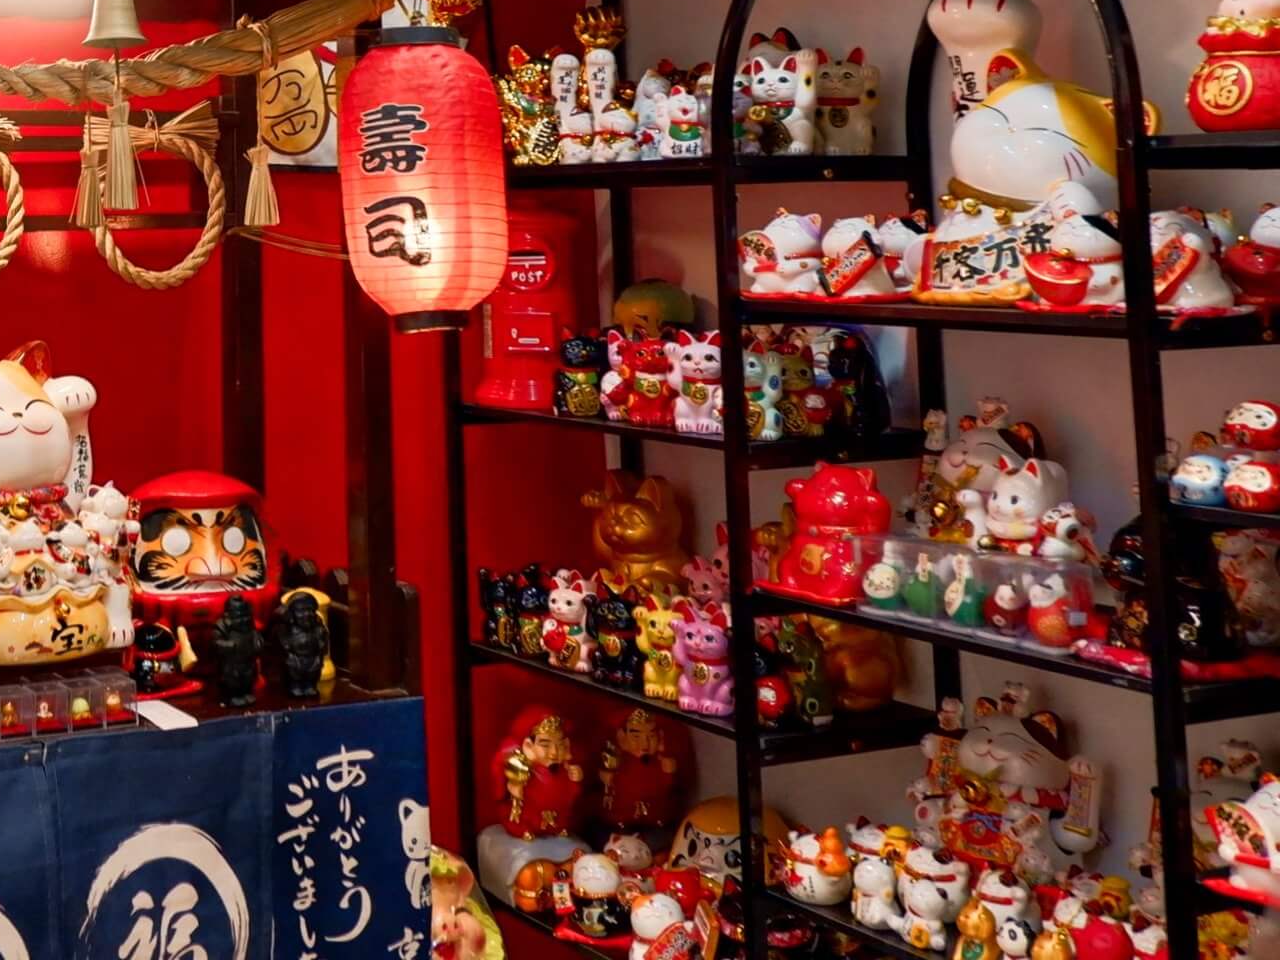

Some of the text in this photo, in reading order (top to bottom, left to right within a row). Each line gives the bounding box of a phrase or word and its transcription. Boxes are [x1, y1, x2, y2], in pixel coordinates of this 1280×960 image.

[1204, 66, 1240, 107] 福
[511, 270, 543, 283] POST
[51, 620, 85, 656] 宝
[316, 744, 374, 942] ありがとう
[277, 773, 320, 960] ございまし
